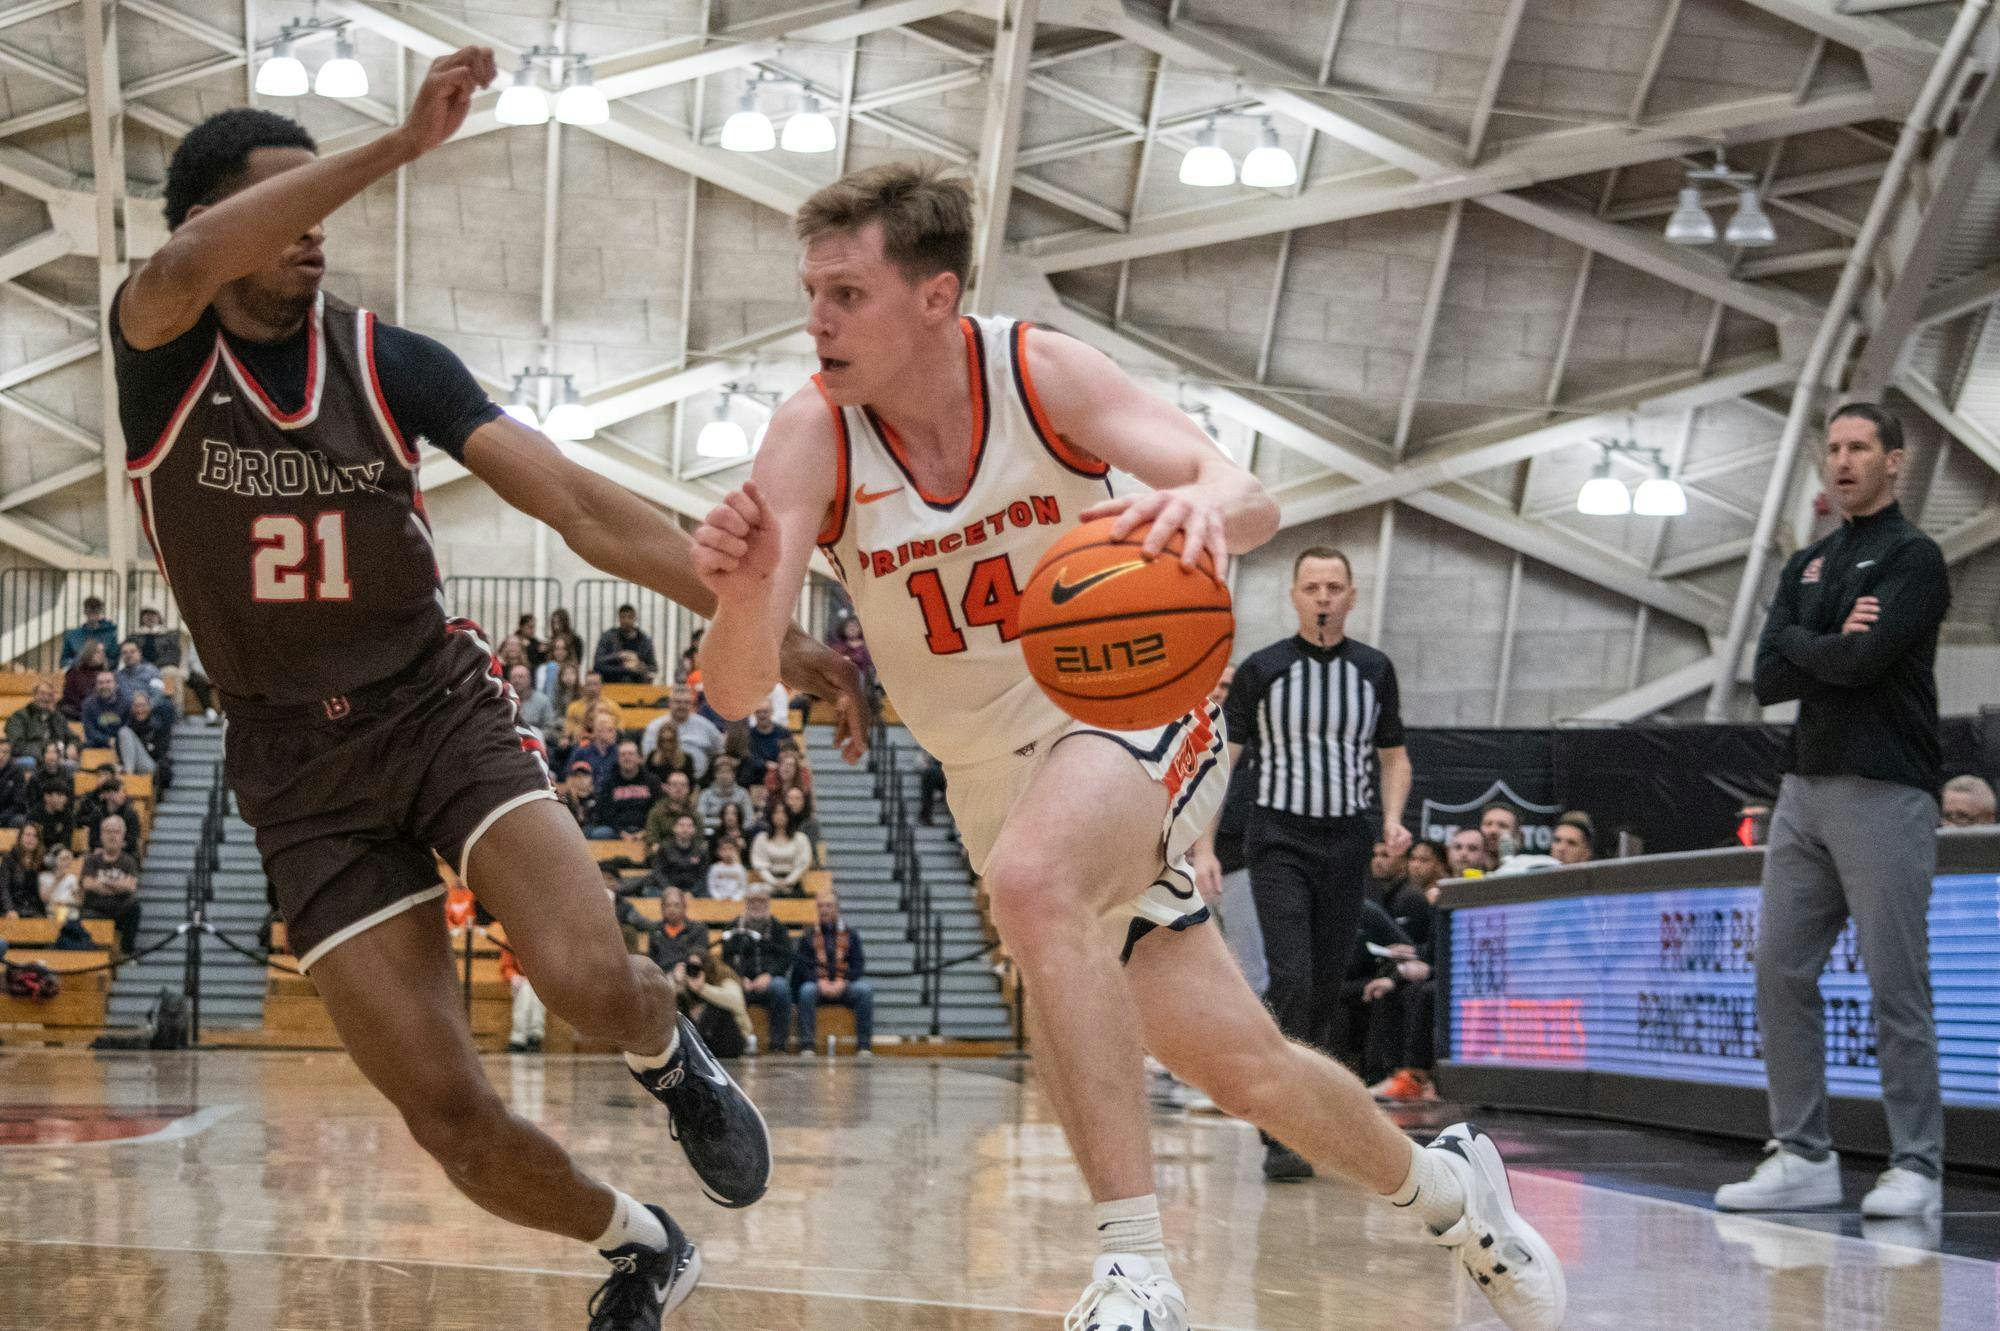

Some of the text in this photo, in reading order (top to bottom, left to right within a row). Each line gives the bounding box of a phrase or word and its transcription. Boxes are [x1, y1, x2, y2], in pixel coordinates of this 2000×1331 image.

[251, 510, 351, 601] 21
[906, 552, 1023, 655] 14
[1053, 632, 1167, 673] ELITE
